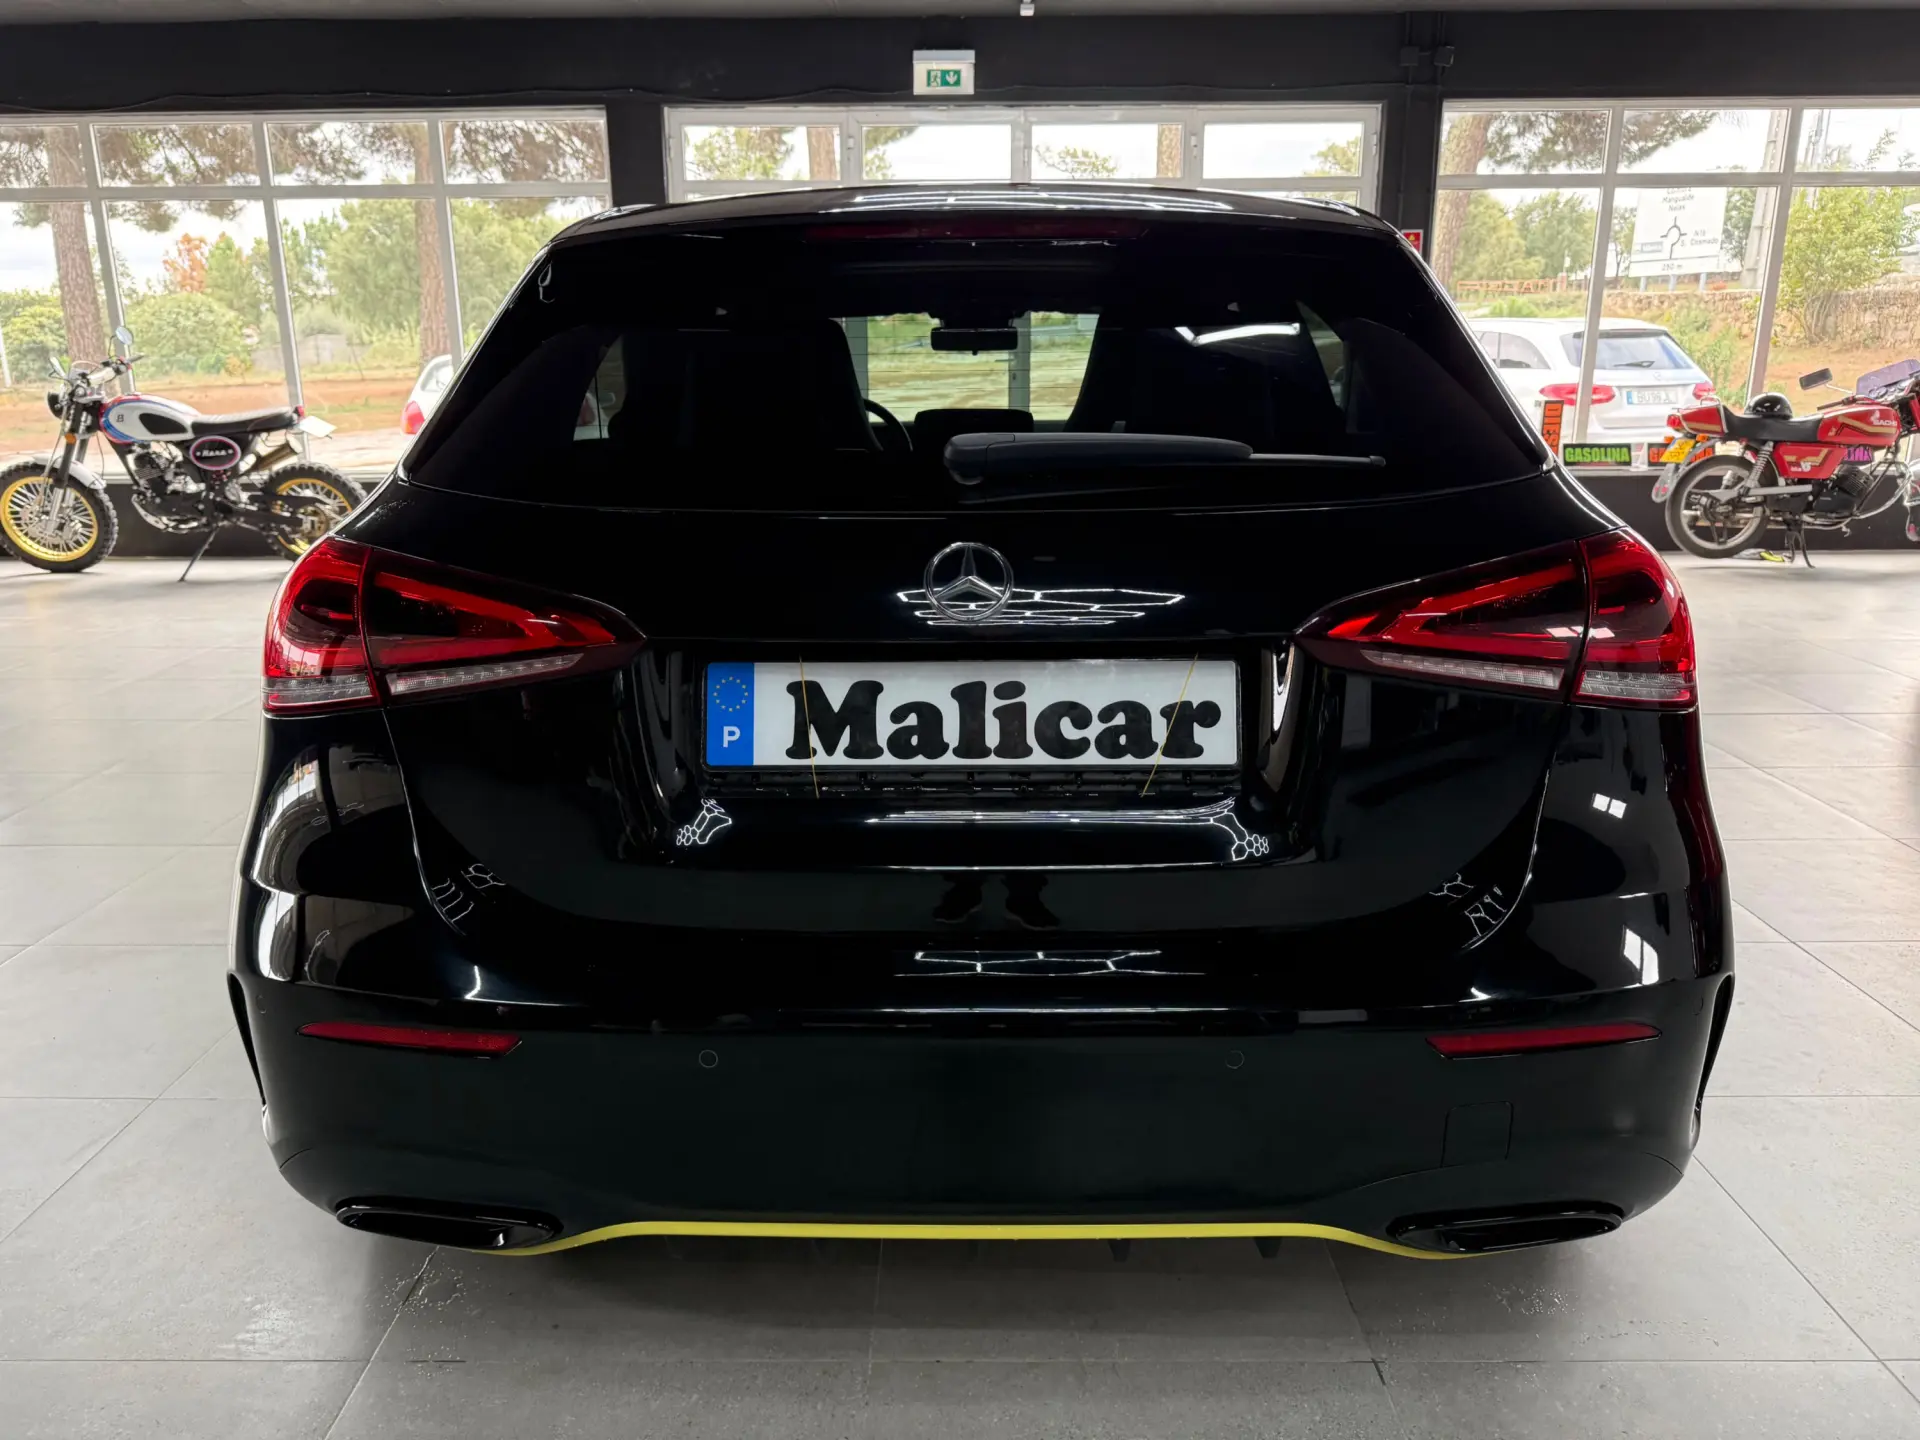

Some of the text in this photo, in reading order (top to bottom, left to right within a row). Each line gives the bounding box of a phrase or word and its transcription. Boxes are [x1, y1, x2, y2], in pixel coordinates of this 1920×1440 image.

[1662, 194, 1695, 204] Mangualde
[1564, 447, 1630, 463] GASOLINA
[722, 680, 1222, 760] P Malicar
